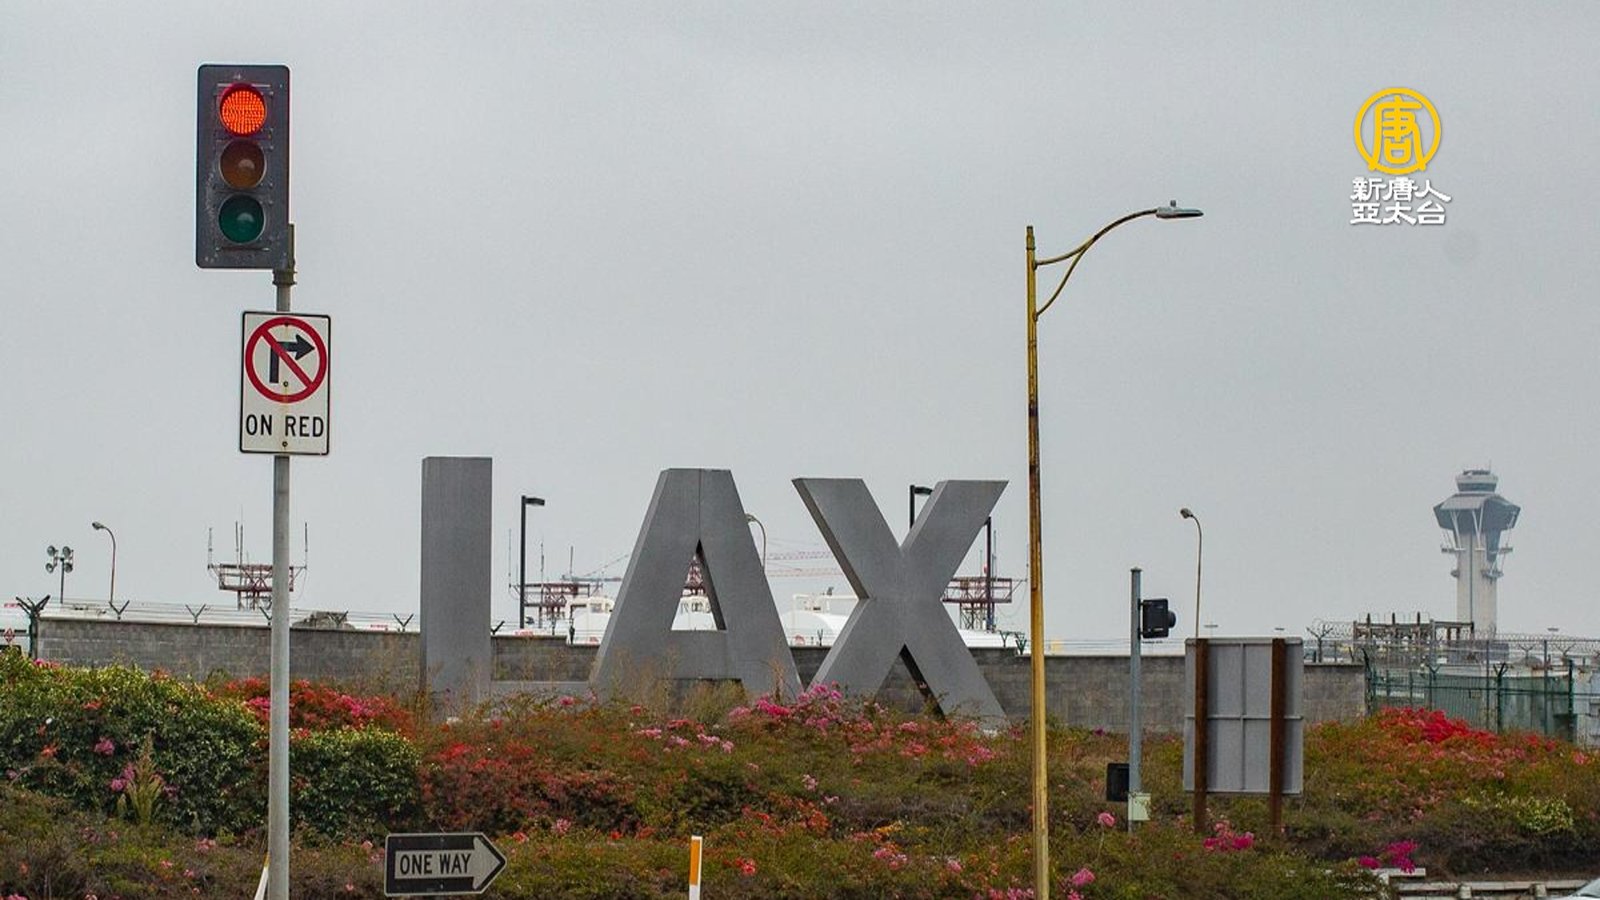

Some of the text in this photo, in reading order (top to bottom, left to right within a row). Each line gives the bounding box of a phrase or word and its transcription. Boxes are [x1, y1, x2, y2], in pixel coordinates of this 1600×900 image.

[246, 414, 324, 437] ON RED
[421, 456, 1009, 719] LAX
[400, 853, 471, 875] ONE WAY
